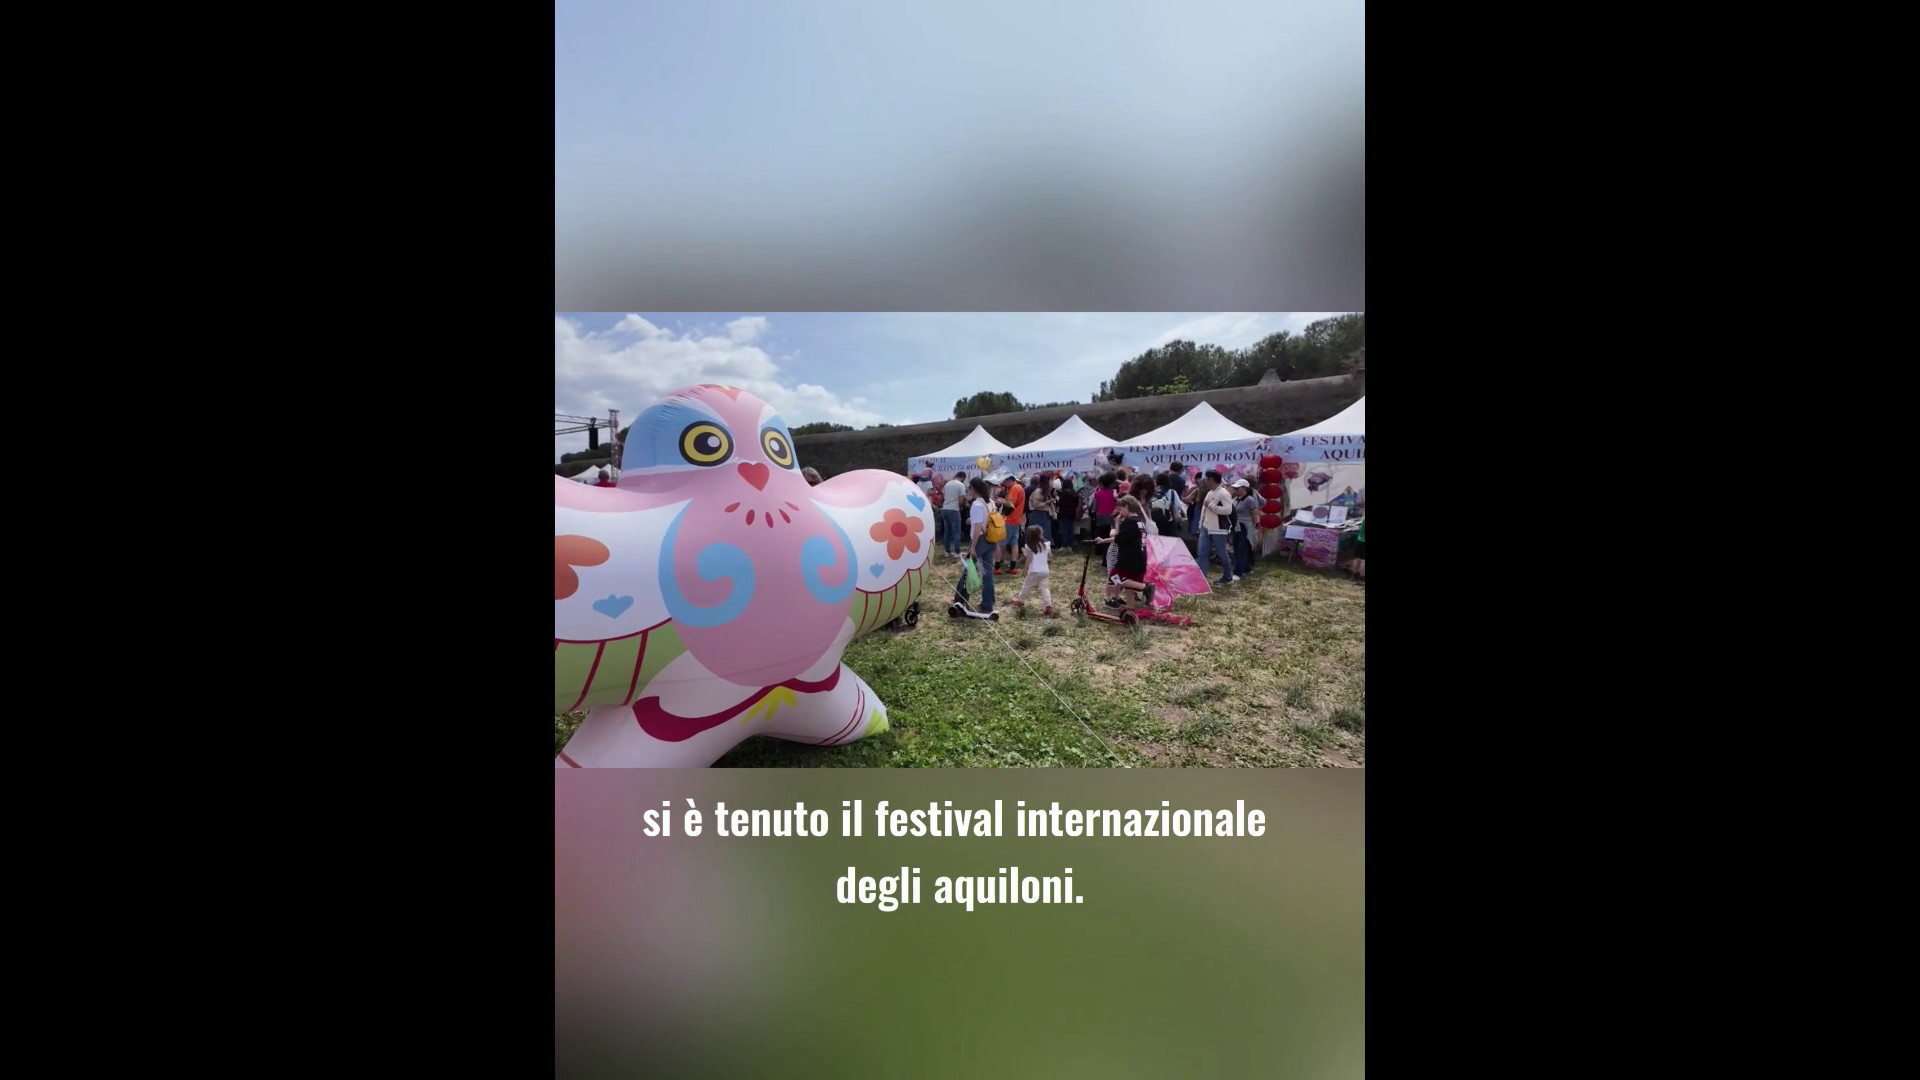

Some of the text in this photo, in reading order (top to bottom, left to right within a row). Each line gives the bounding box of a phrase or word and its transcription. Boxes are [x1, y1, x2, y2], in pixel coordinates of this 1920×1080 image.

[1129, 443, 1185, 453] FESTIVAL
[1007, 451, 1045, 460] FESTIVAL
[1144, 453, 1203, 466] AQUILONI
[1207, 453, 1220, 462] DI
[1018, 459, 1073, 470] AQUILONI DI
